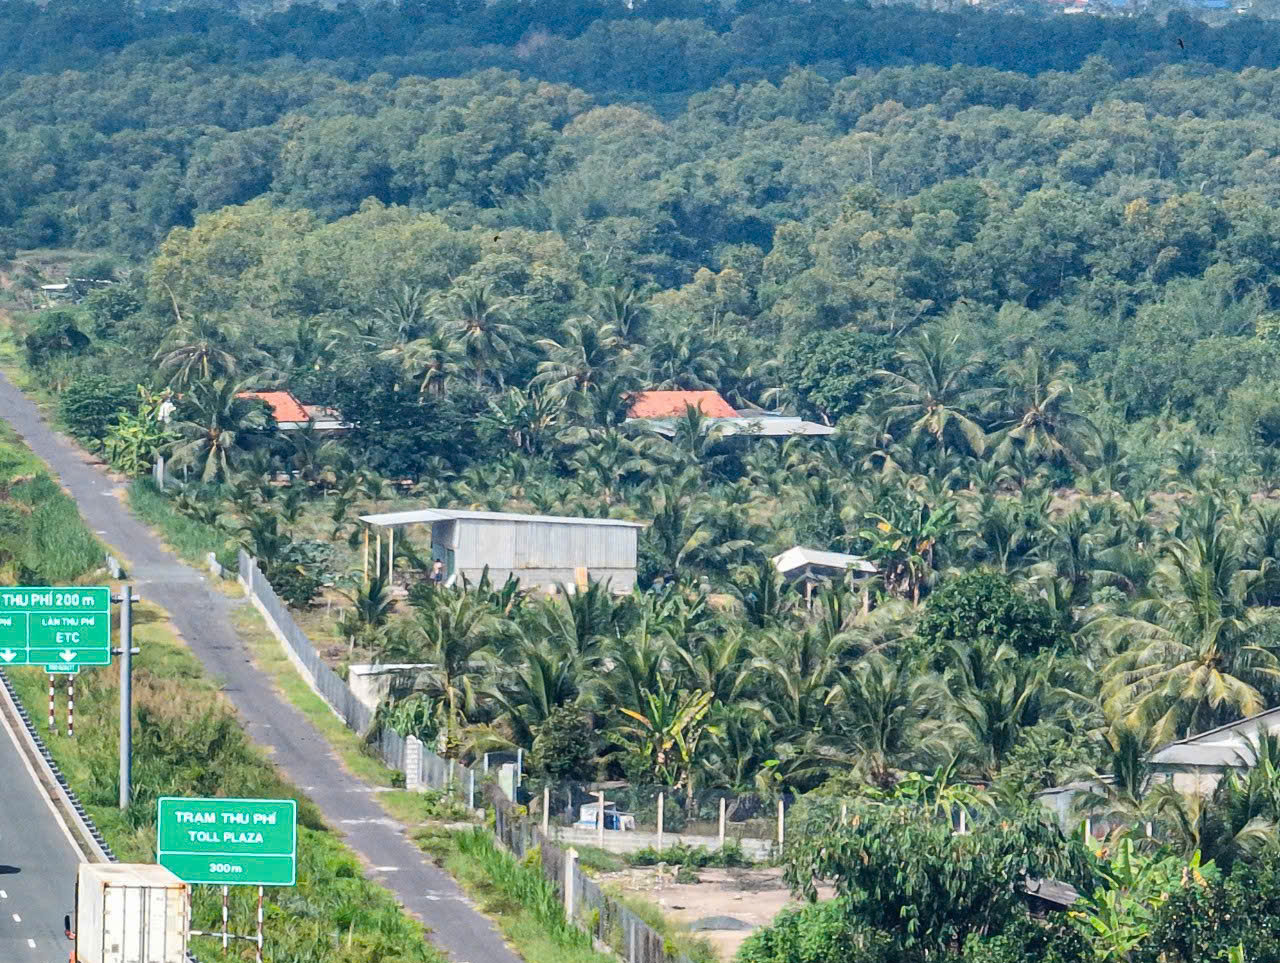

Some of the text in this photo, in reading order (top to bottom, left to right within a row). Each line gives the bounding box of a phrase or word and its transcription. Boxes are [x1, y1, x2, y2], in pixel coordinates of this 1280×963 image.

[2, 593, 29, 607] THU
[31, 591, 53, 607] PHÍ
[55, 593, 80, 606] 200
[81, 596, 95, 606] m
[61, 617, 79, 626] THU
[56, 631, 80, 643] ETC
[221, 812, 250, 824] THU
[252, 812, 277, 825] PHÍ
[187, 830, 263, 844] TOLL PLAZA
